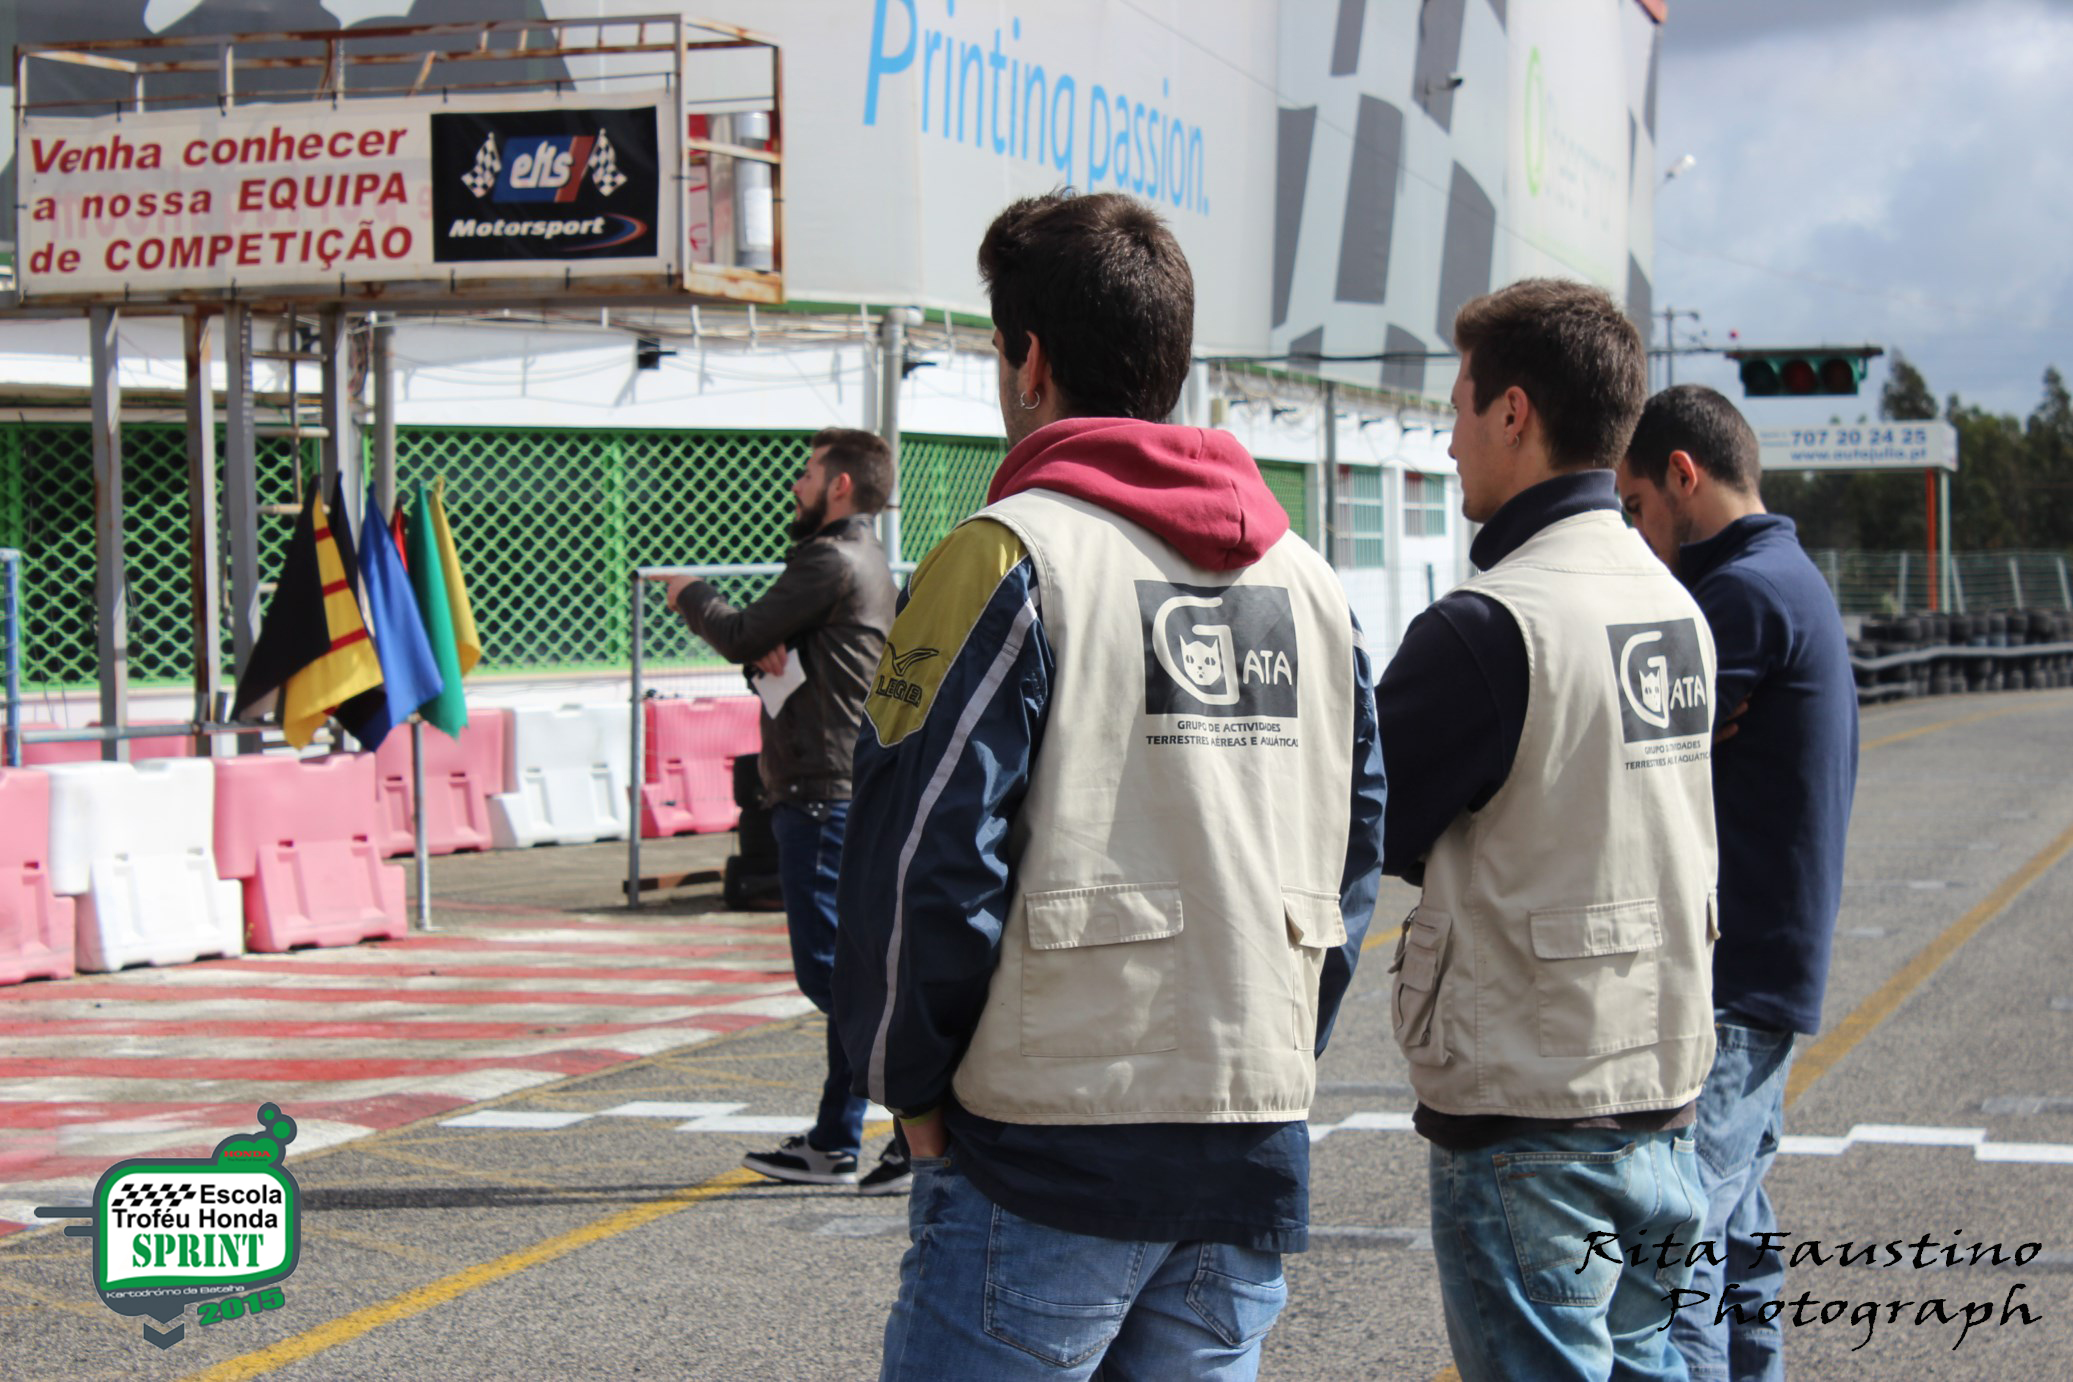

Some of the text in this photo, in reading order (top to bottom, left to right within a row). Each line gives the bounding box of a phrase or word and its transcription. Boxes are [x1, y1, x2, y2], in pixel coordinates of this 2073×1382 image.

[863, 0, 1077, 193] Printing
[30, 127, 408, 174] Venha conhecer
[33, 172, 408, 221] a nossa EQUIPA
[29, 220, 413, 274] de COMPETIÇÃO
[449, 216, 605, 240] Motorsport
[1791, 429, 1828, 447] 707
[1837, 429, 1861, 446] 20
[1870, 428, 1893, 445] 24
[1903, 428, 1927, 445] 25
[1152, 595, 1293, 706] GATA
[1620, 630, 1706, 729] GATA
[1146, 735, 1209, 745] TERRESTRES
[1211, 736, 1247, 747] AÉREAS
[1250, 736, 1258, 745] E
[1177, 720, 1207, 731] GRUPO
[1208, 723, 1220, 732] DE
